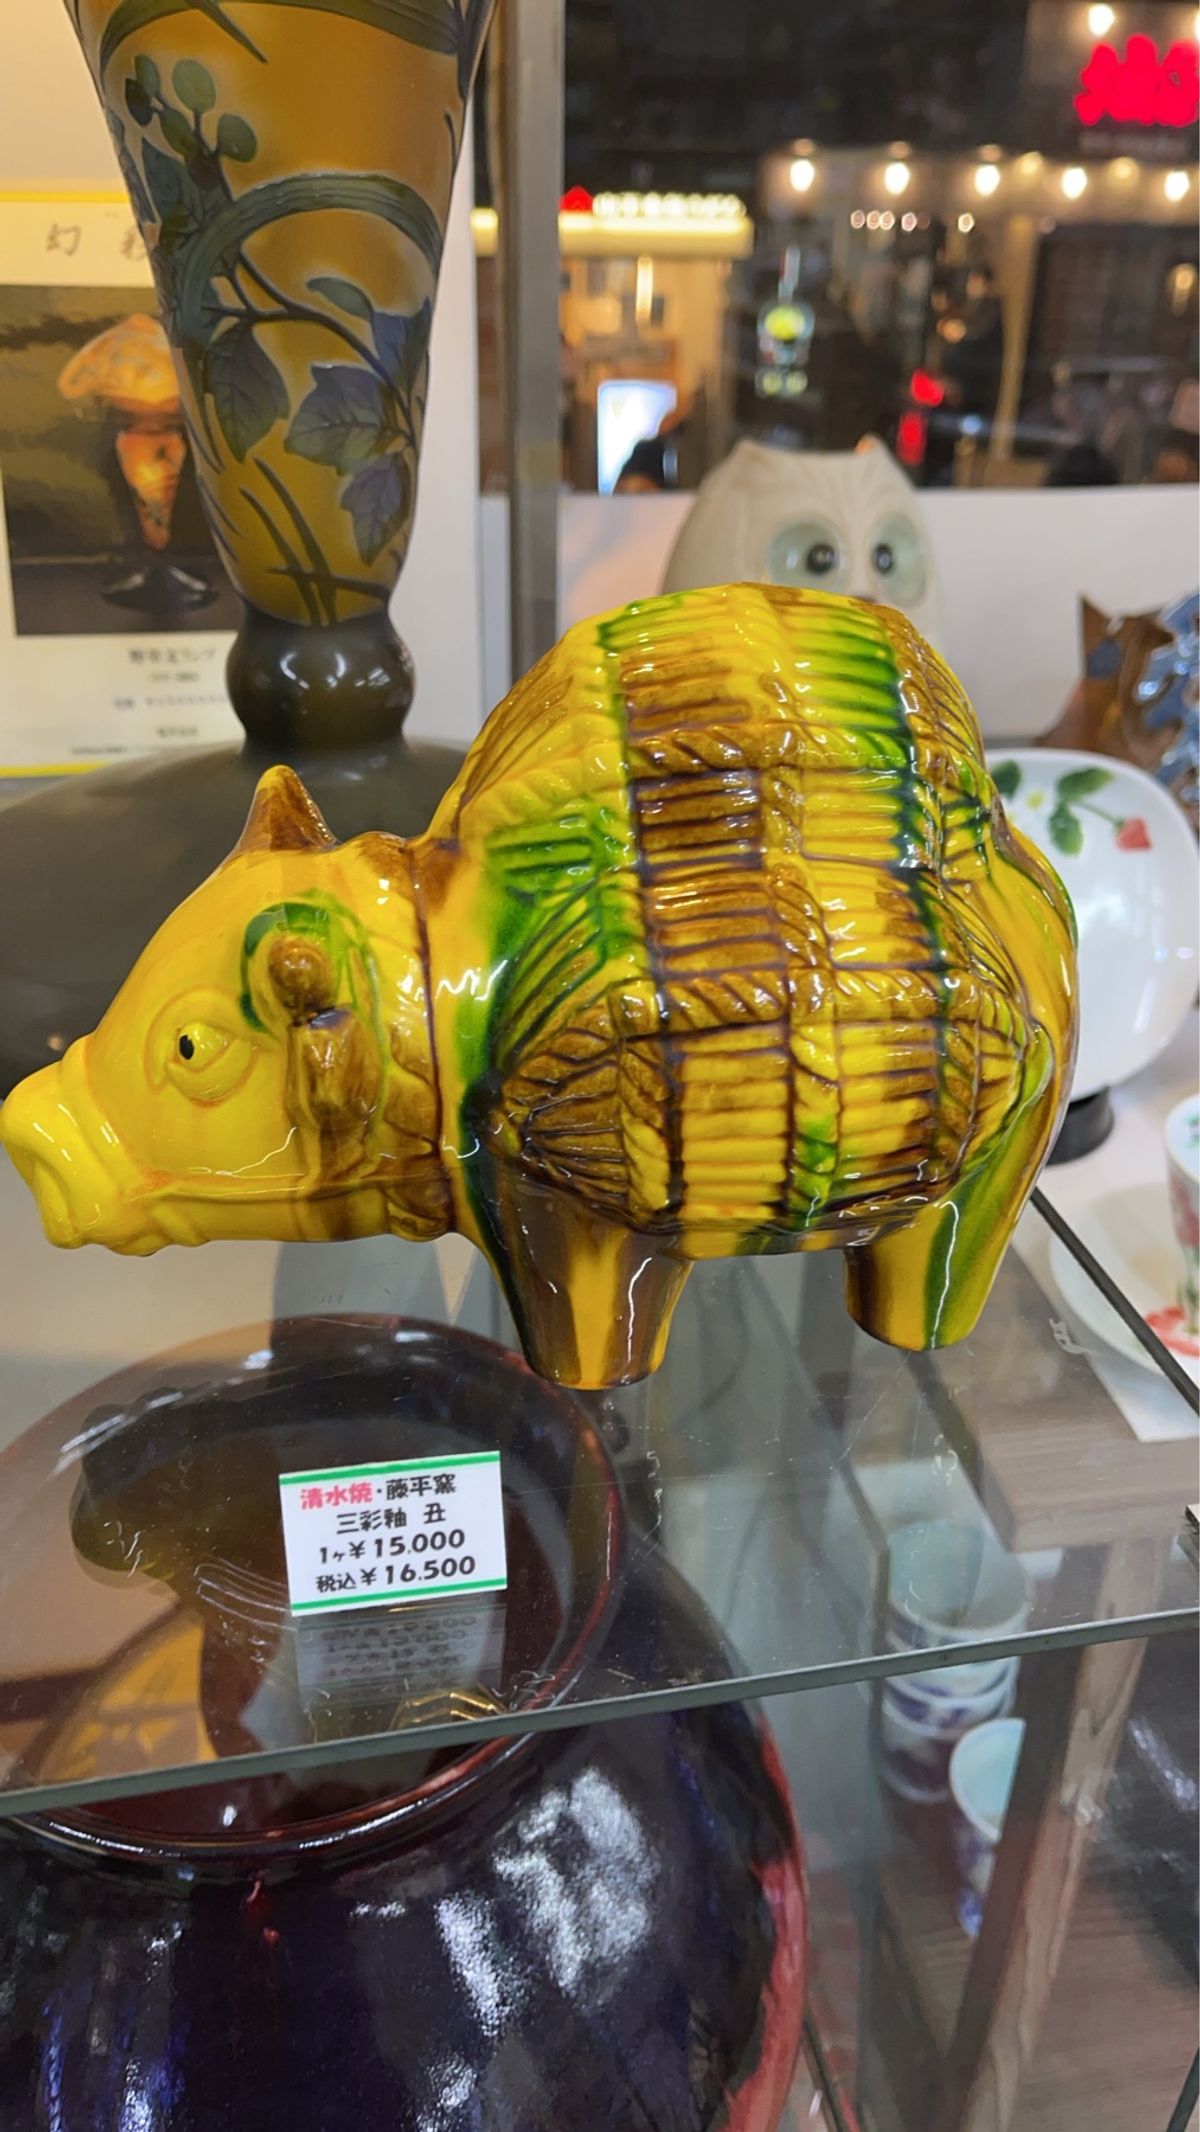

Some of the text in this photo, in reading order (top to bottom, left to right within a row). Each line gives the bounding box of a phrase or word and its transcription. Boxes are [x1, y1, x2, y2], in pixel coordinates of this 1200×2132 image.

[336, 1502, 446, 1535] 三彩釉 丑
